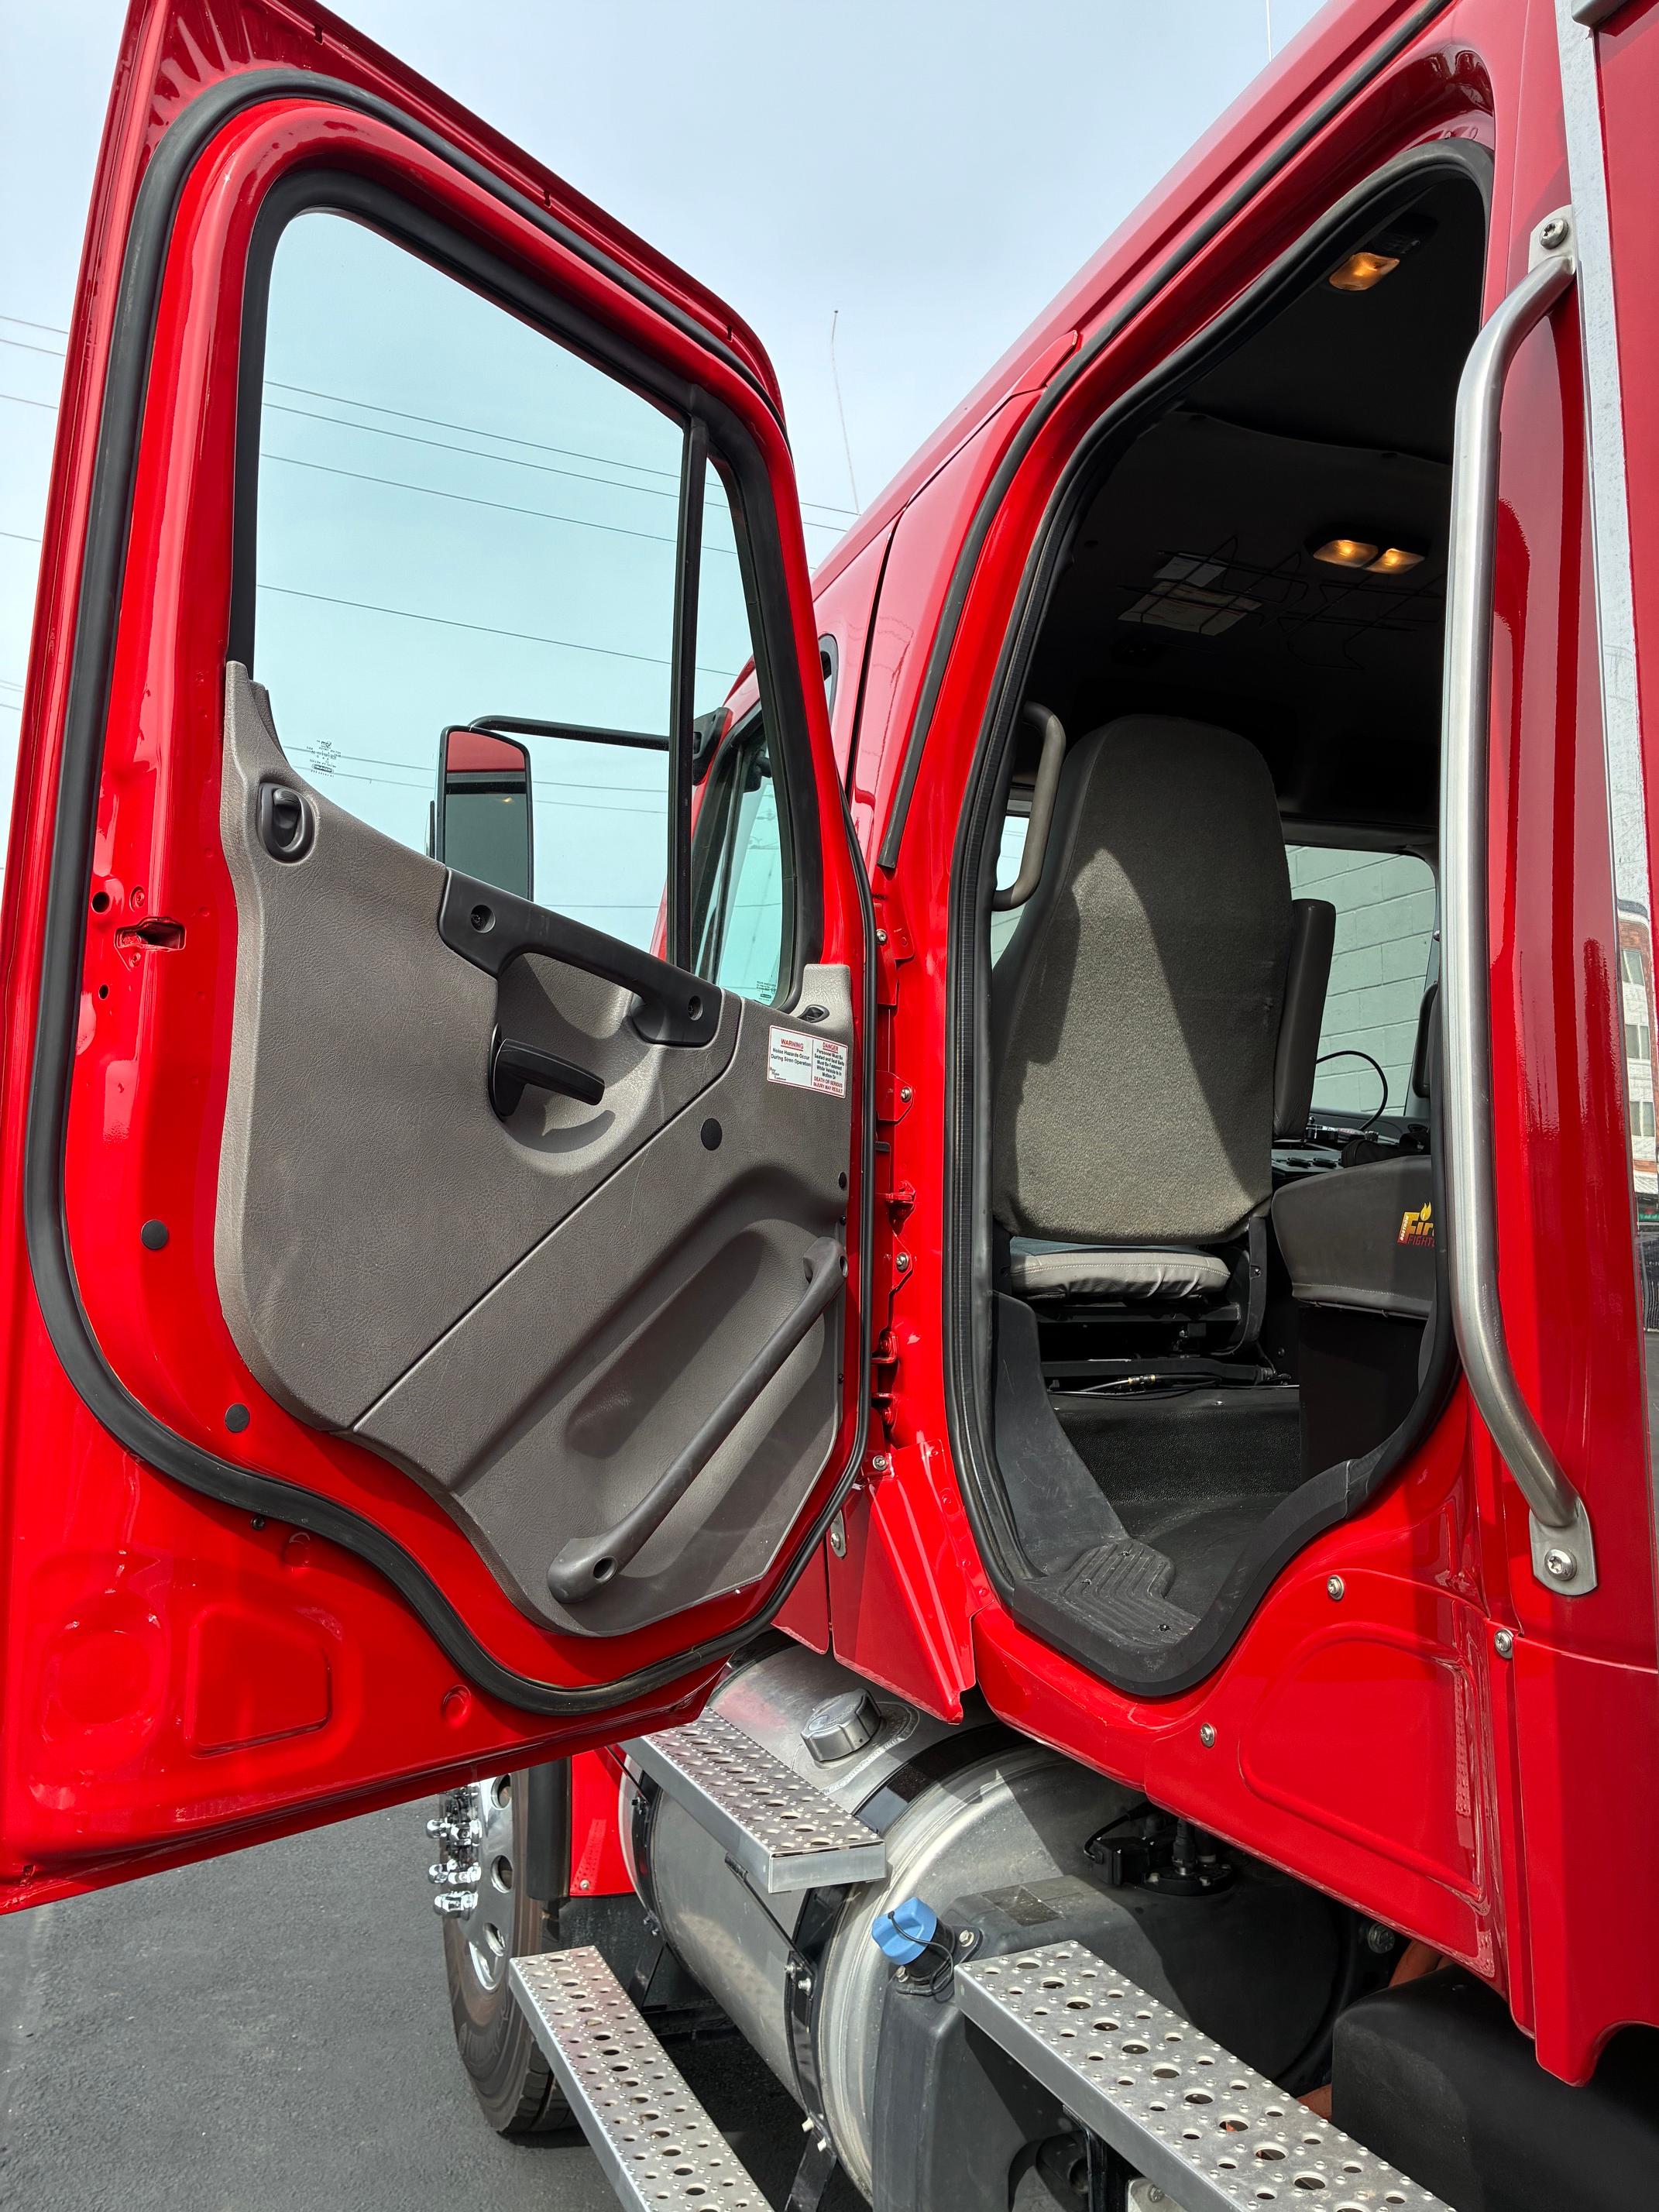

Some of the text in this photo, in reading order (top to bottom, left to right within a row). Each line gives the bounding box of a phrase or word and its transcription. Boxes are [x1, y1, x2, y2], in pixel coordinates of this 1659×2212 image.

[781, 1039, 803, 1049] WARNING
[823, 1042, 838, 1051] DANGER
[1398, 1202, 1434, 1244] Fir
